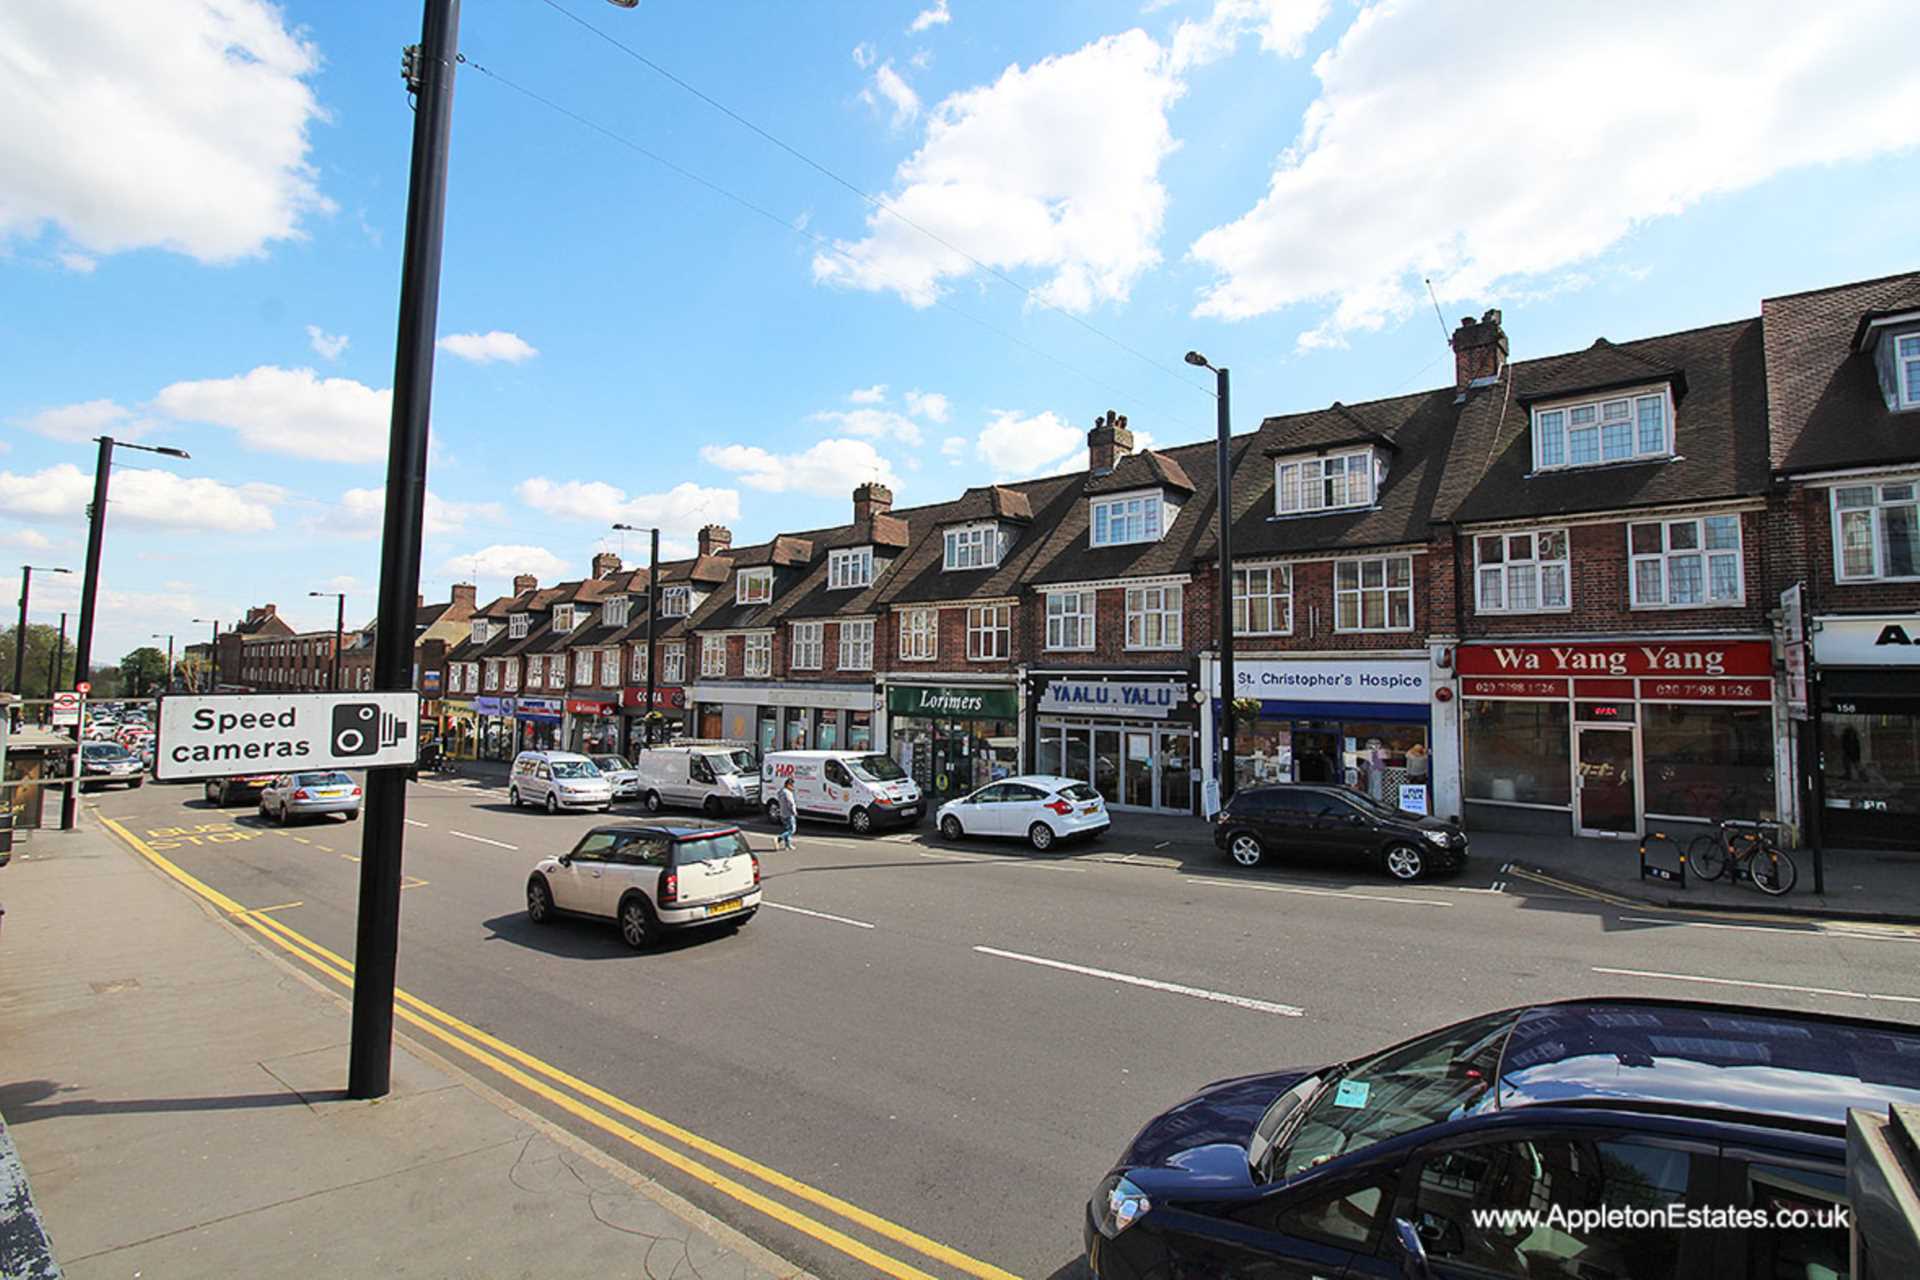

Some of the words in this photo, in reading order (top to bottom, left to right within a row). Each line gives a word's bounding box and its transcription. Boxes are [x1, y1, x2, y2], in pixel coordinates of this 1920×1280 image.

[1493, 648, 1540, 669] Wa
[1551, 648, 1627, 675] Yang
[1641, 648, 1725, 675] Yang
[1237, 672, 1255, 685] St.
[1261, 672, 1352, 687] Christopher's
[1360, 674, 1422, 689] Hospice
[1656, 684, 1680, 695] 020
[1721, 685, 1753, 696] 126
[636, 691, 665, 703] COA
[920, 690, 983, 713] Lorimers
[1052, 685, 1109, 703] YAALU
[1121, 687, 1171, 705] YALU
[192, 706, 296, 734] Speed
[172, 740, 310, 763] cameras
